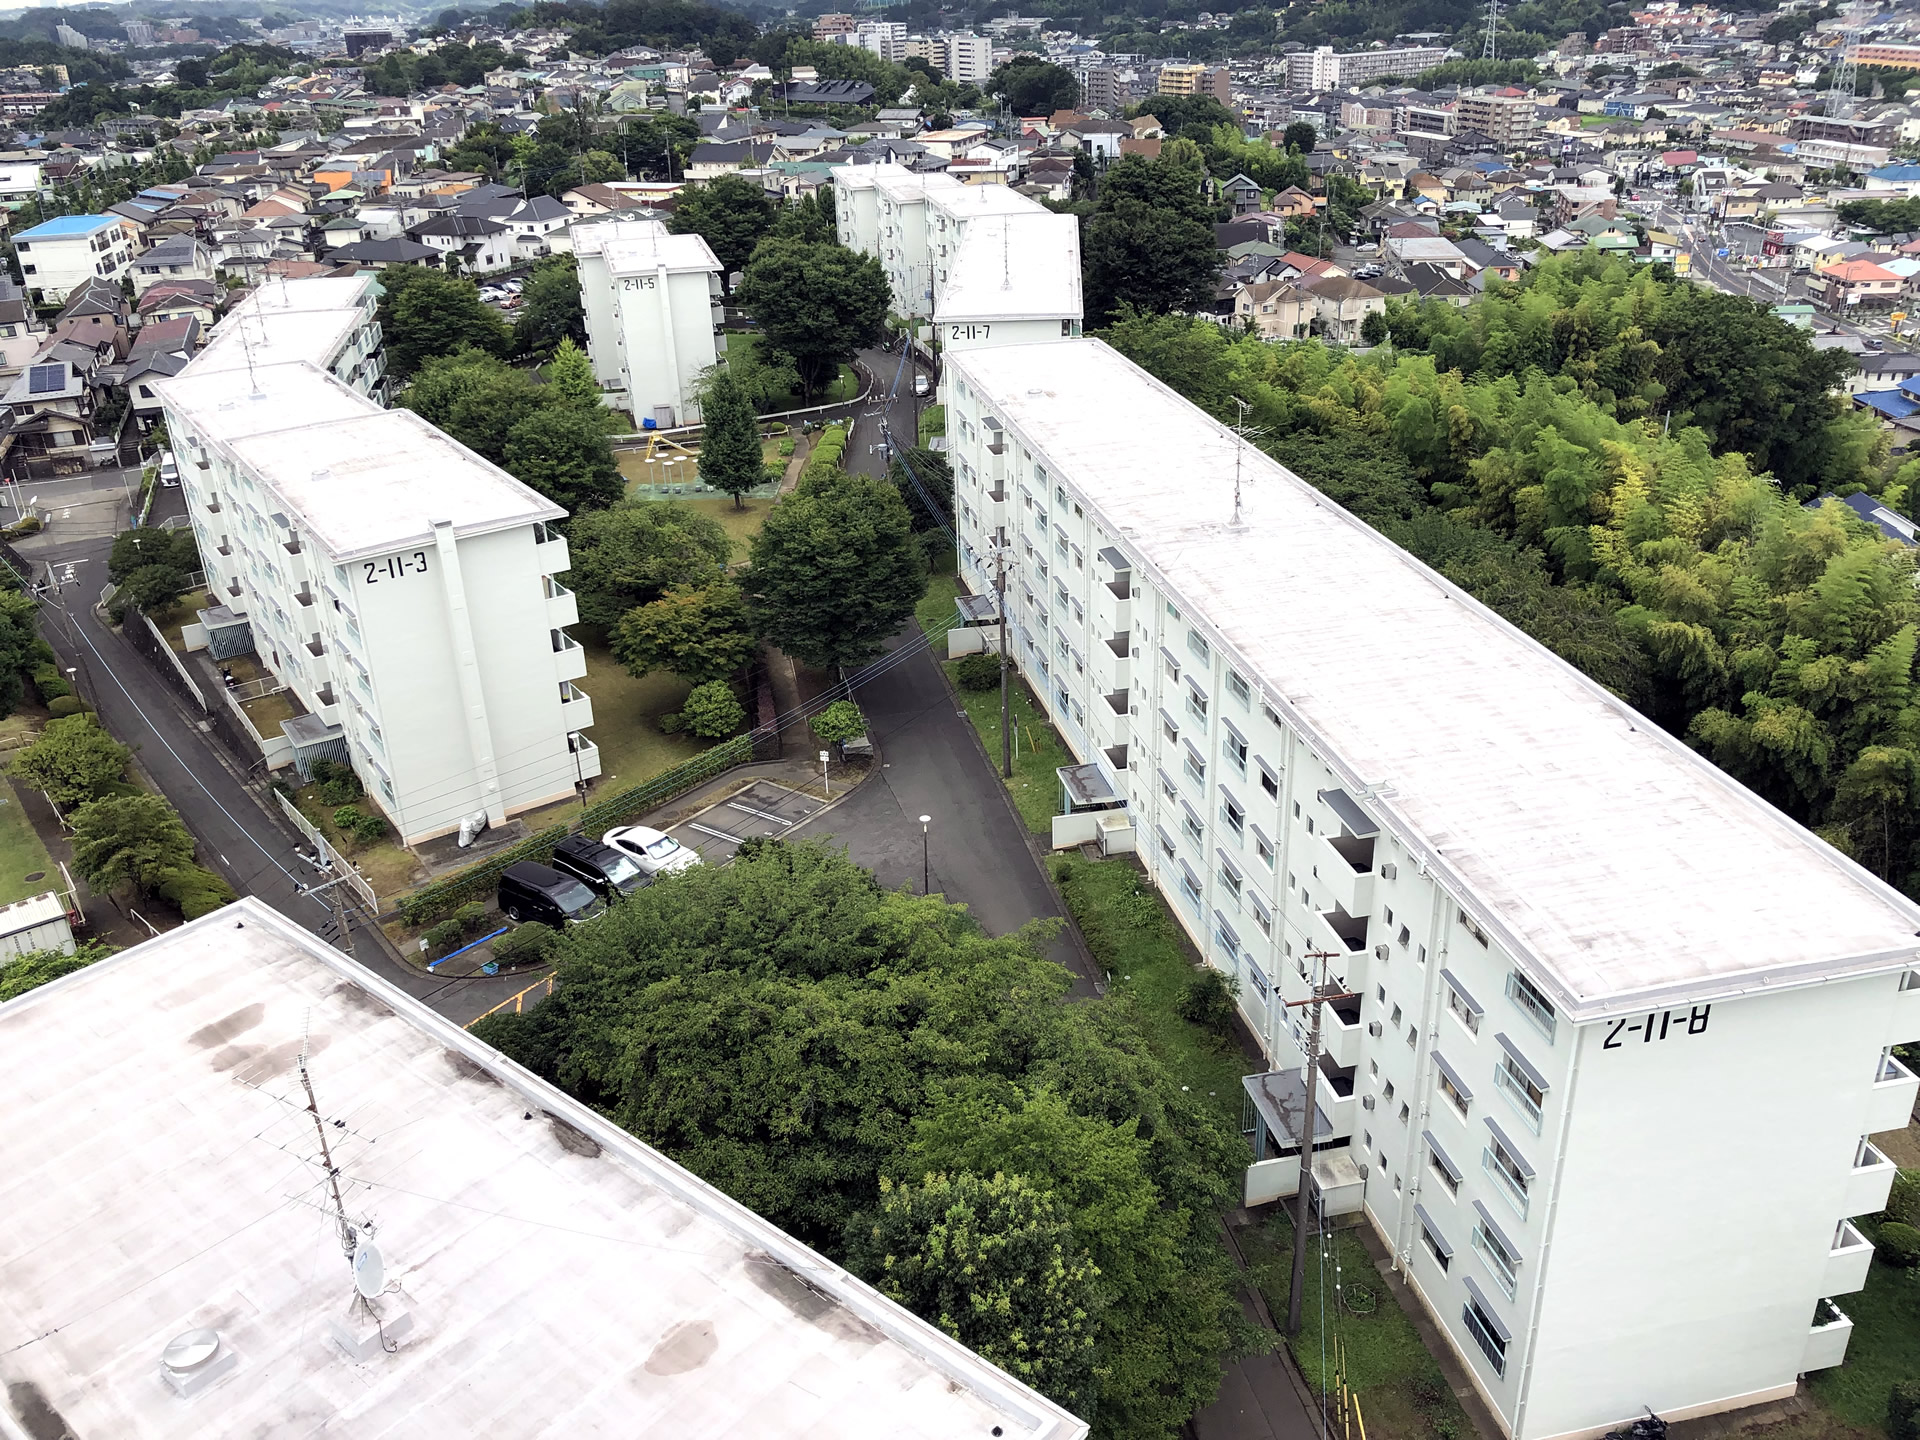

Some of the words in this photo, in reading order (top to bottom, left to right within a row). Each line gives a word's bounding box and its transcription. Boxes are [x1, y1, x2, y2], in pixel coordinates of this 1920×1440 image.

[624, 277, 655, 291] 2-11-5
[952, 325, 990, 340] 2-11-7
[364, 552, 427, 584] 2-11-3
[1603, 1004, 1711, 1049] 2-11-8
